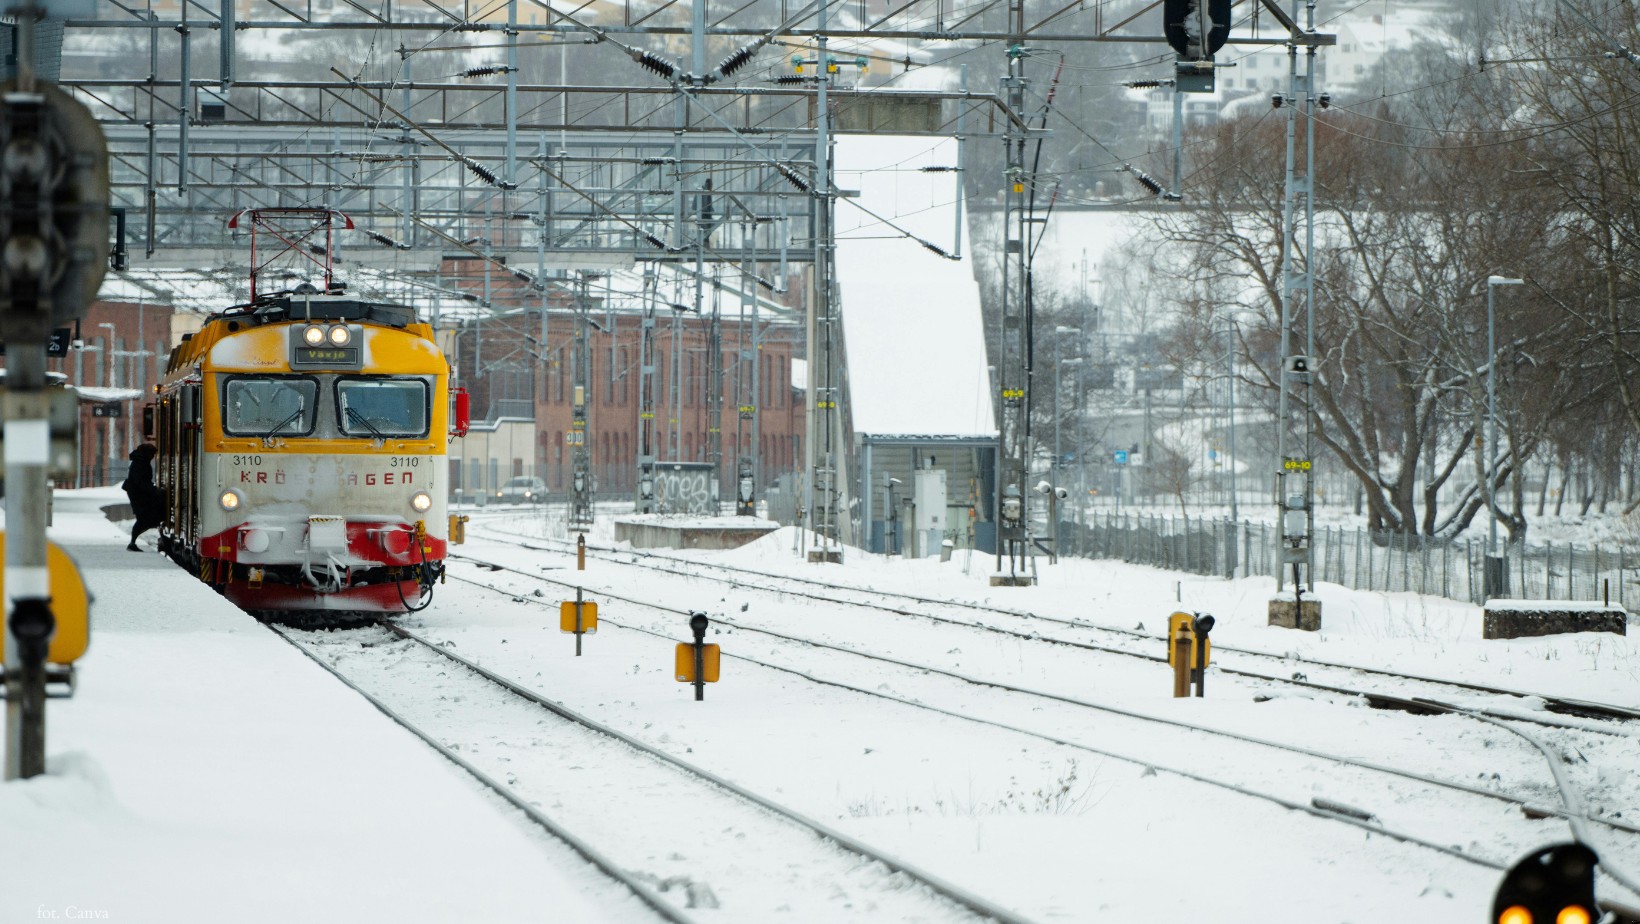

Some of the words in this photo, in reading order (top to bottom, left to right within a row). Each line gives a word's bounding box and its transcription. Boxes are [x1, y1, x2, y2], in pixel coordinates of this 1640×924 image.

[308, 350, 346, 360] Växjö
[1003, 389, 1024, 398] 69-9
[817, 401, 836, 409] 698
[233, 455, 262, 466] 3110
[390, 457, 419, 468] 3110
[1284, 461, 1311, 469] 69-10
